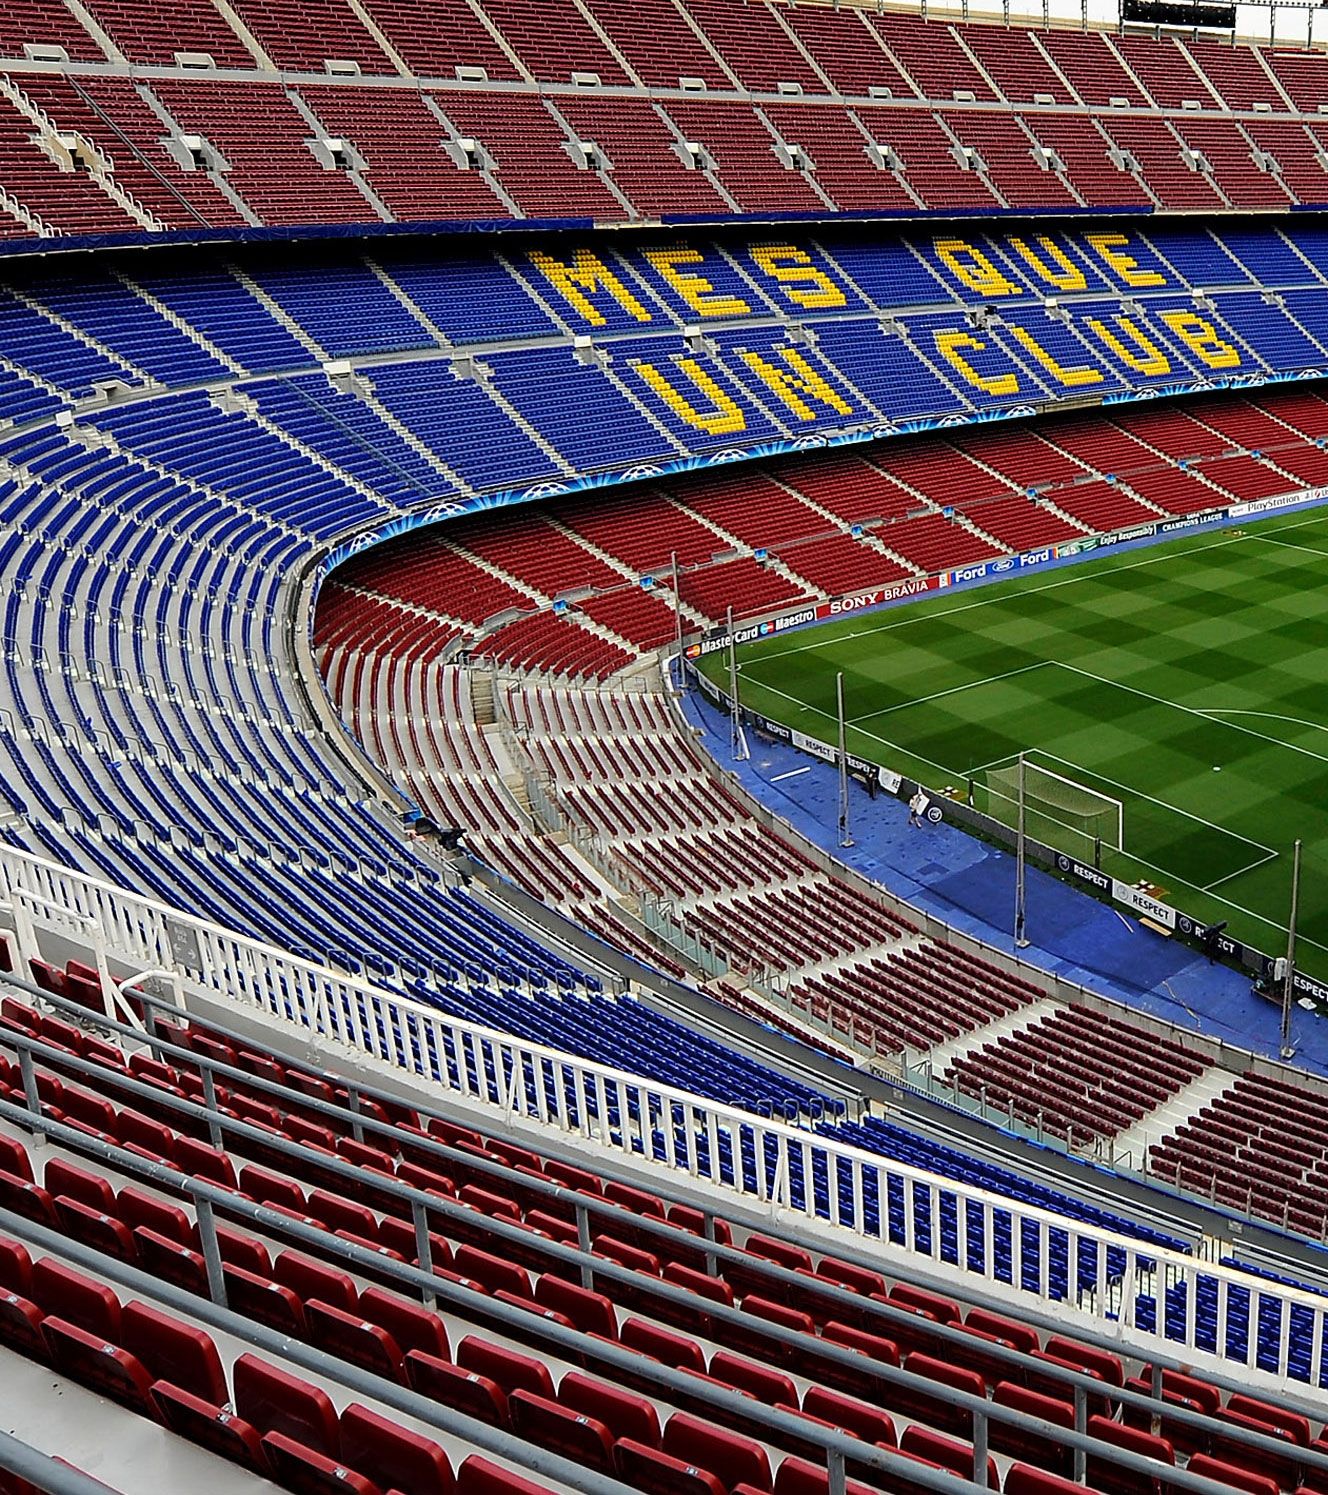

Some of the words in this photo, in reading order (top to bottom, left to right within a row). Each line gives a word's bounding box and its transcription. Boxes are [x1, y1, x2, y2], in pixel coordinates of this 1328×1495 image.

[528, 241, 847, 326] MES
[933, 231, 1167, 296] QUE
[627, 346, 854, 435] UN
[933, 309, 1242, 396] CLUB
[1248, 495, 1300, 511] PlayStation
[1200, 512, 1224, 524] LEAGUE
[1020, 550, 1049, 567] Ford
[955, 565, 986, 583] Ford
[830, 592, 880, 615] SONY
[884, 579, 929, 601] BRAVIA
[701, 625, 758, 653] MasterCard
[775, 610, 814, 631] Maestro
[805, 739, 831, 757] RESPECT
[1073, 864, 1108, 889] RESPECT
[1132, 894, 1169, 920] RESPECT
